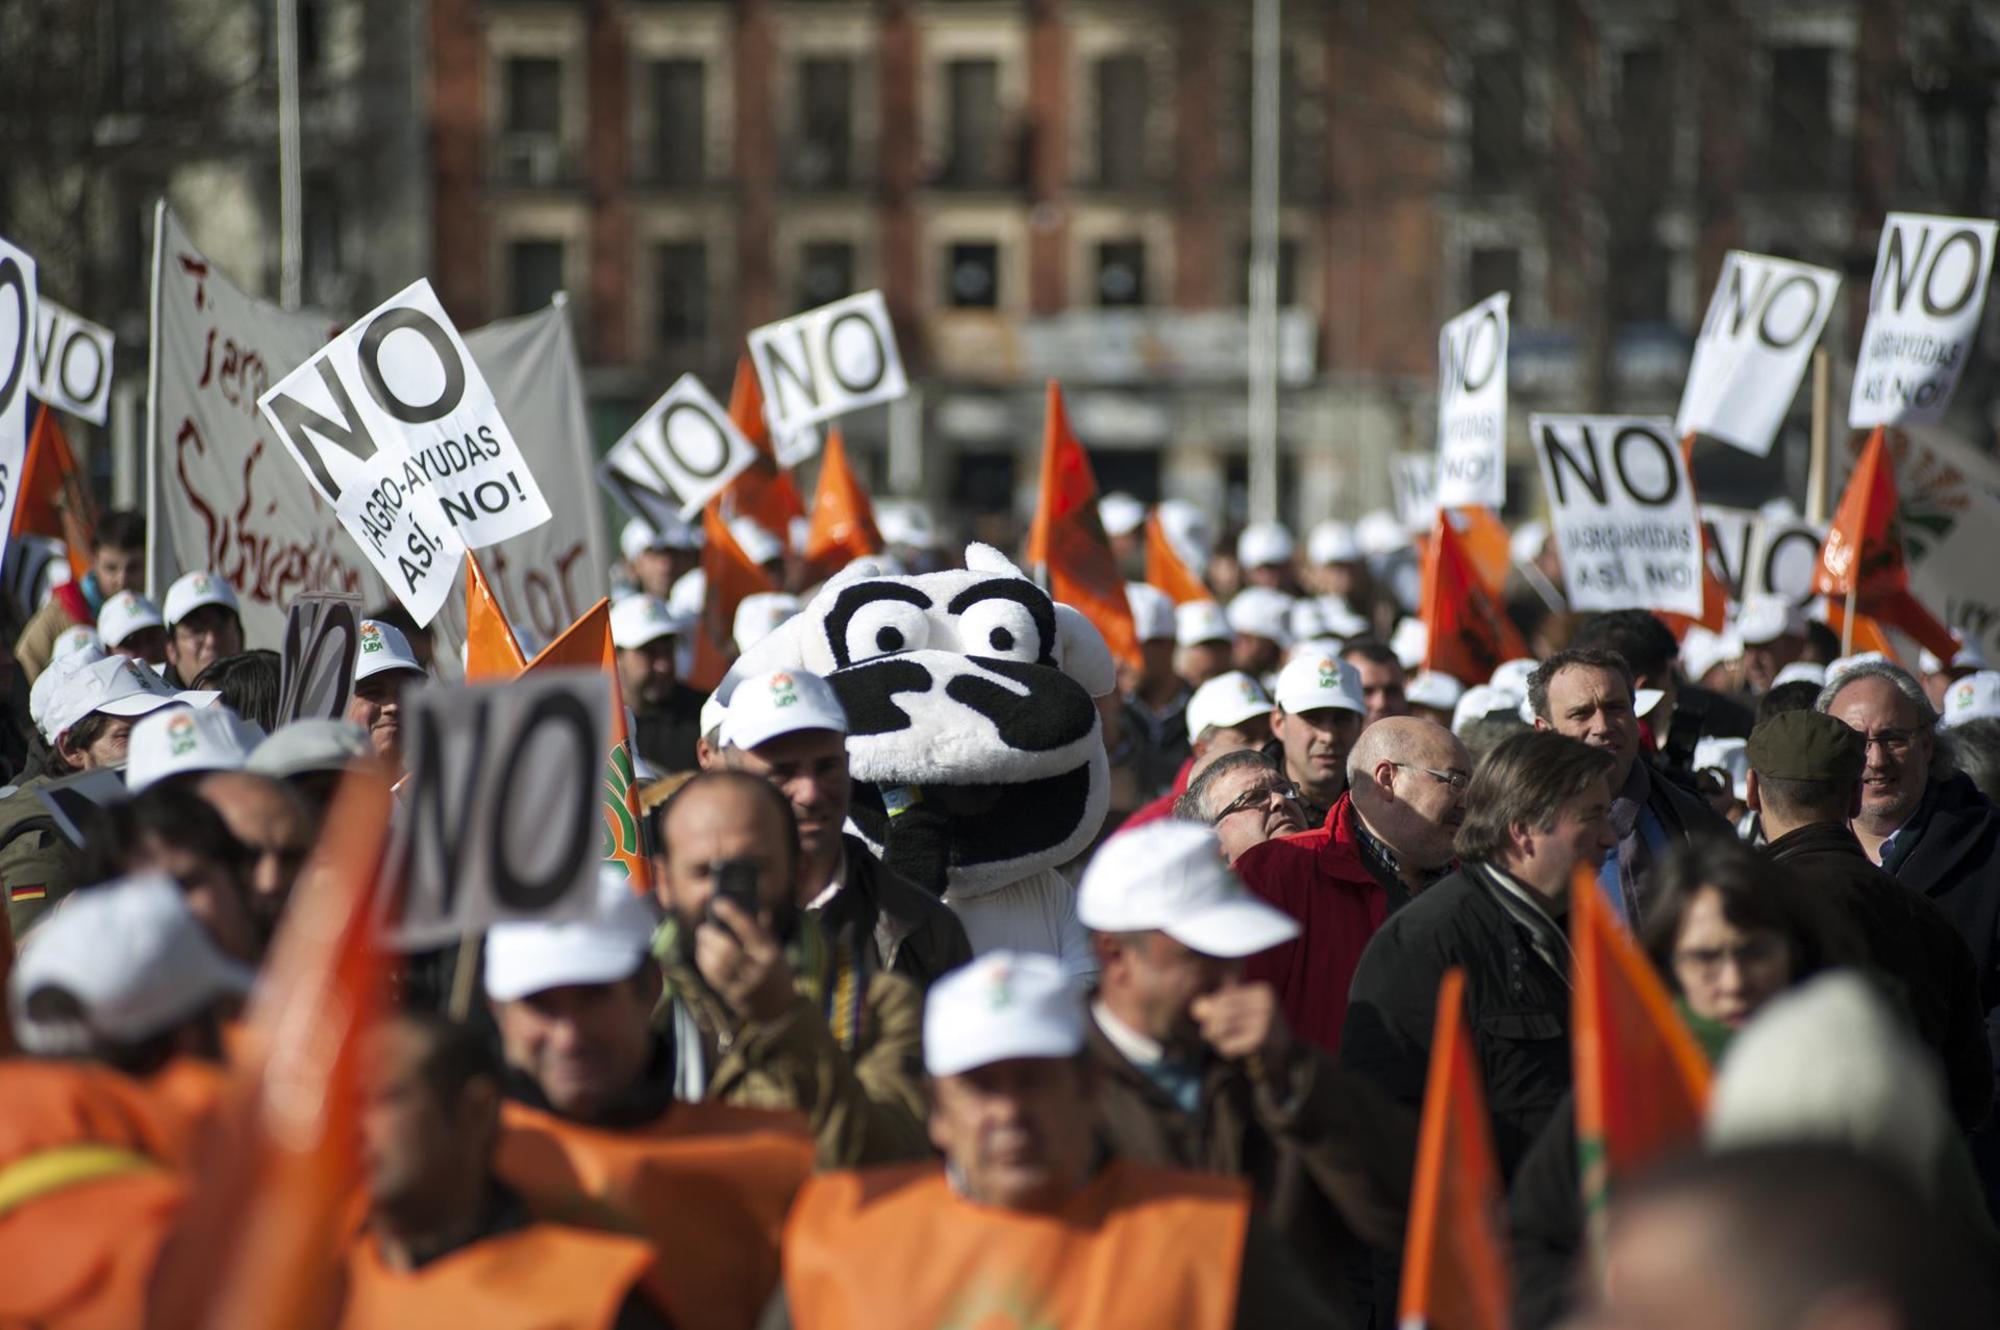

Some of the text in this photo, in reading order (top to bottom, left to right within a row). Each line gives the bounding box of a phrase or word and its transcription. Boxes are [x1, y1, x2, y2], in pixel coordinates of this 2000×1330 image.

[1713, 265, 1820, 349] NO
[1875, 225, 1982, 318] NO
[0, 257, 28, 416] O
[763, 312, 886, 420] NO
[1444, 310, 1499, 396] NO
[268, 306, 466, 502] NO
[362, 425, 501, 558] ¡AGRO-AYUDAS
[608, 402, 731, 534] NO
[1542, 424, 1680, 506] NO
[398, 470, 528, 595] ASÍ, NO!
[281, 601, 356, 722] NO
[363, 641, 383, 653] UPA
[388, 686, 598, 918] NO
